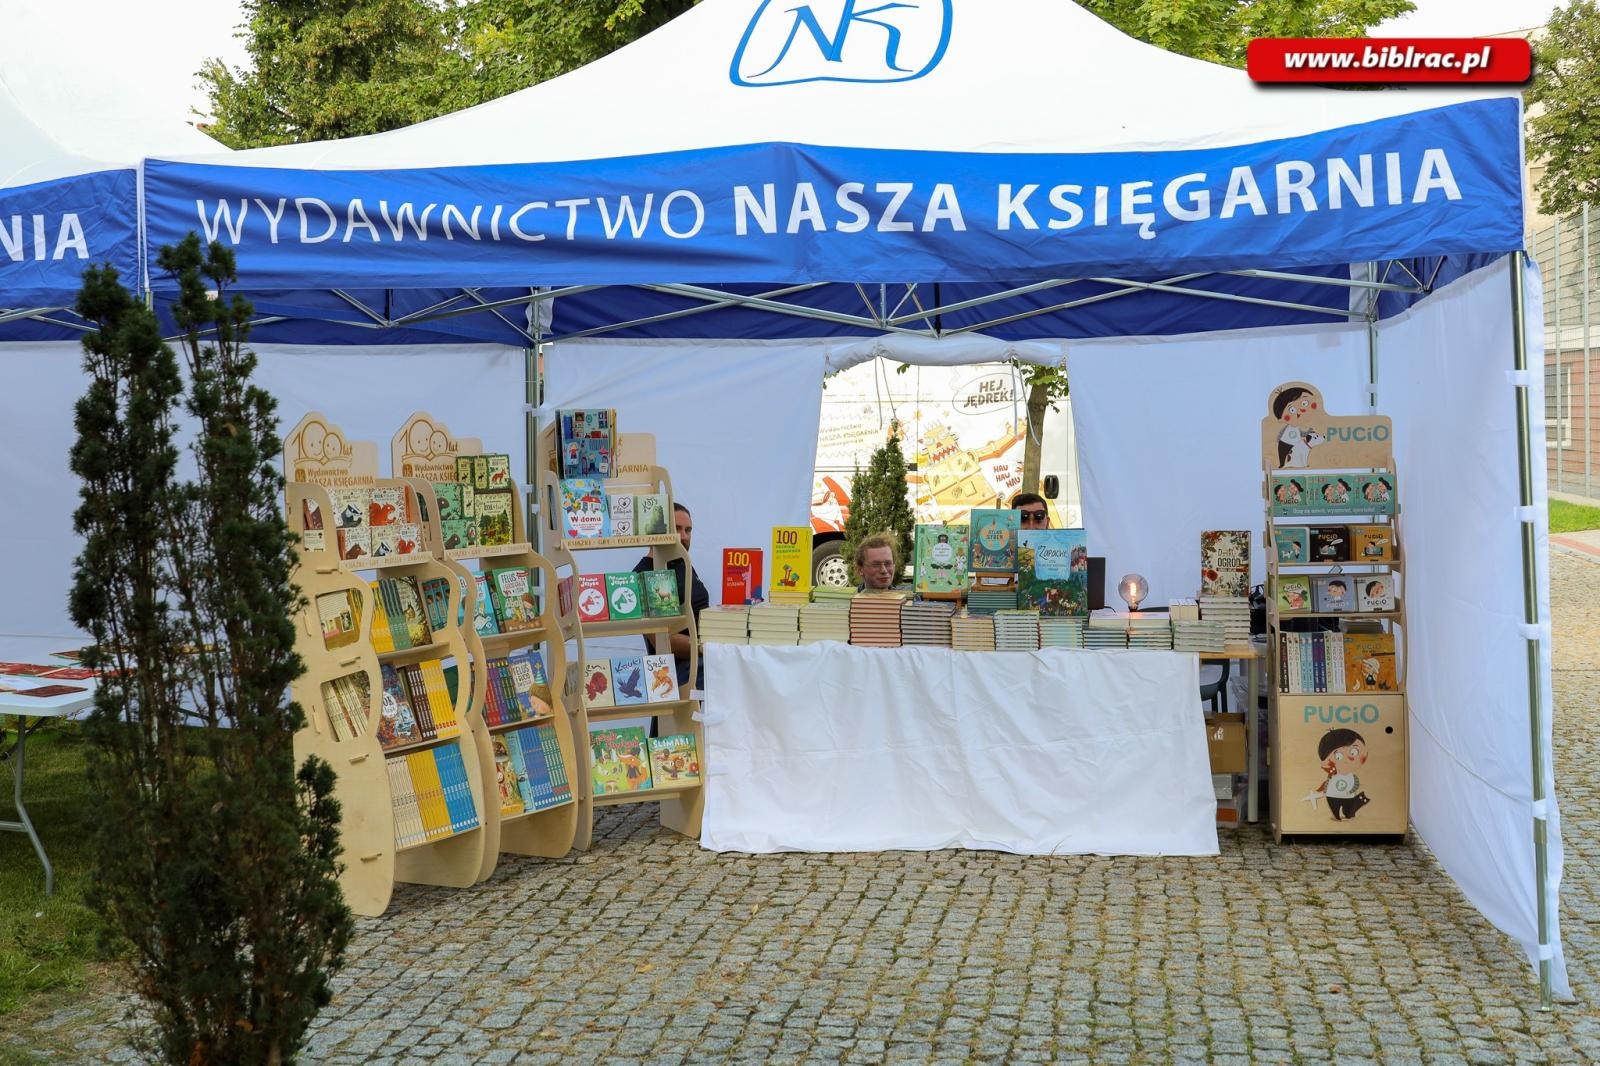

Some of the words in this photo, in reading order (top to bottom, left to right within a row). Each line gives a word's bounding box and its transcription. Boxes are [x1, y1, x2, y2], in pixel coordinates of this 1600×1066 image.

[196, 189, 706, 246] WYDAWNICTWO
[733, 182, 967, 236] NASZA
[997, 148, 1463, 240] KSIĘGARNIA
[963, 389, 1014, 409] JĘDREK!
[307, 468, 349, 478] Wydawnictwo
[414, 463, 455, 474] Wydawnictwo
[993, 464, 1008, 473] HAU
[333, 474, 374, 488] KSIĘGARNIA
[996, 472, 1010, 482] HAU
[1006, 476, 1021, 488] HAU
[775, 530, 798, 545] 100
[727, 551, 750, 567] 100
